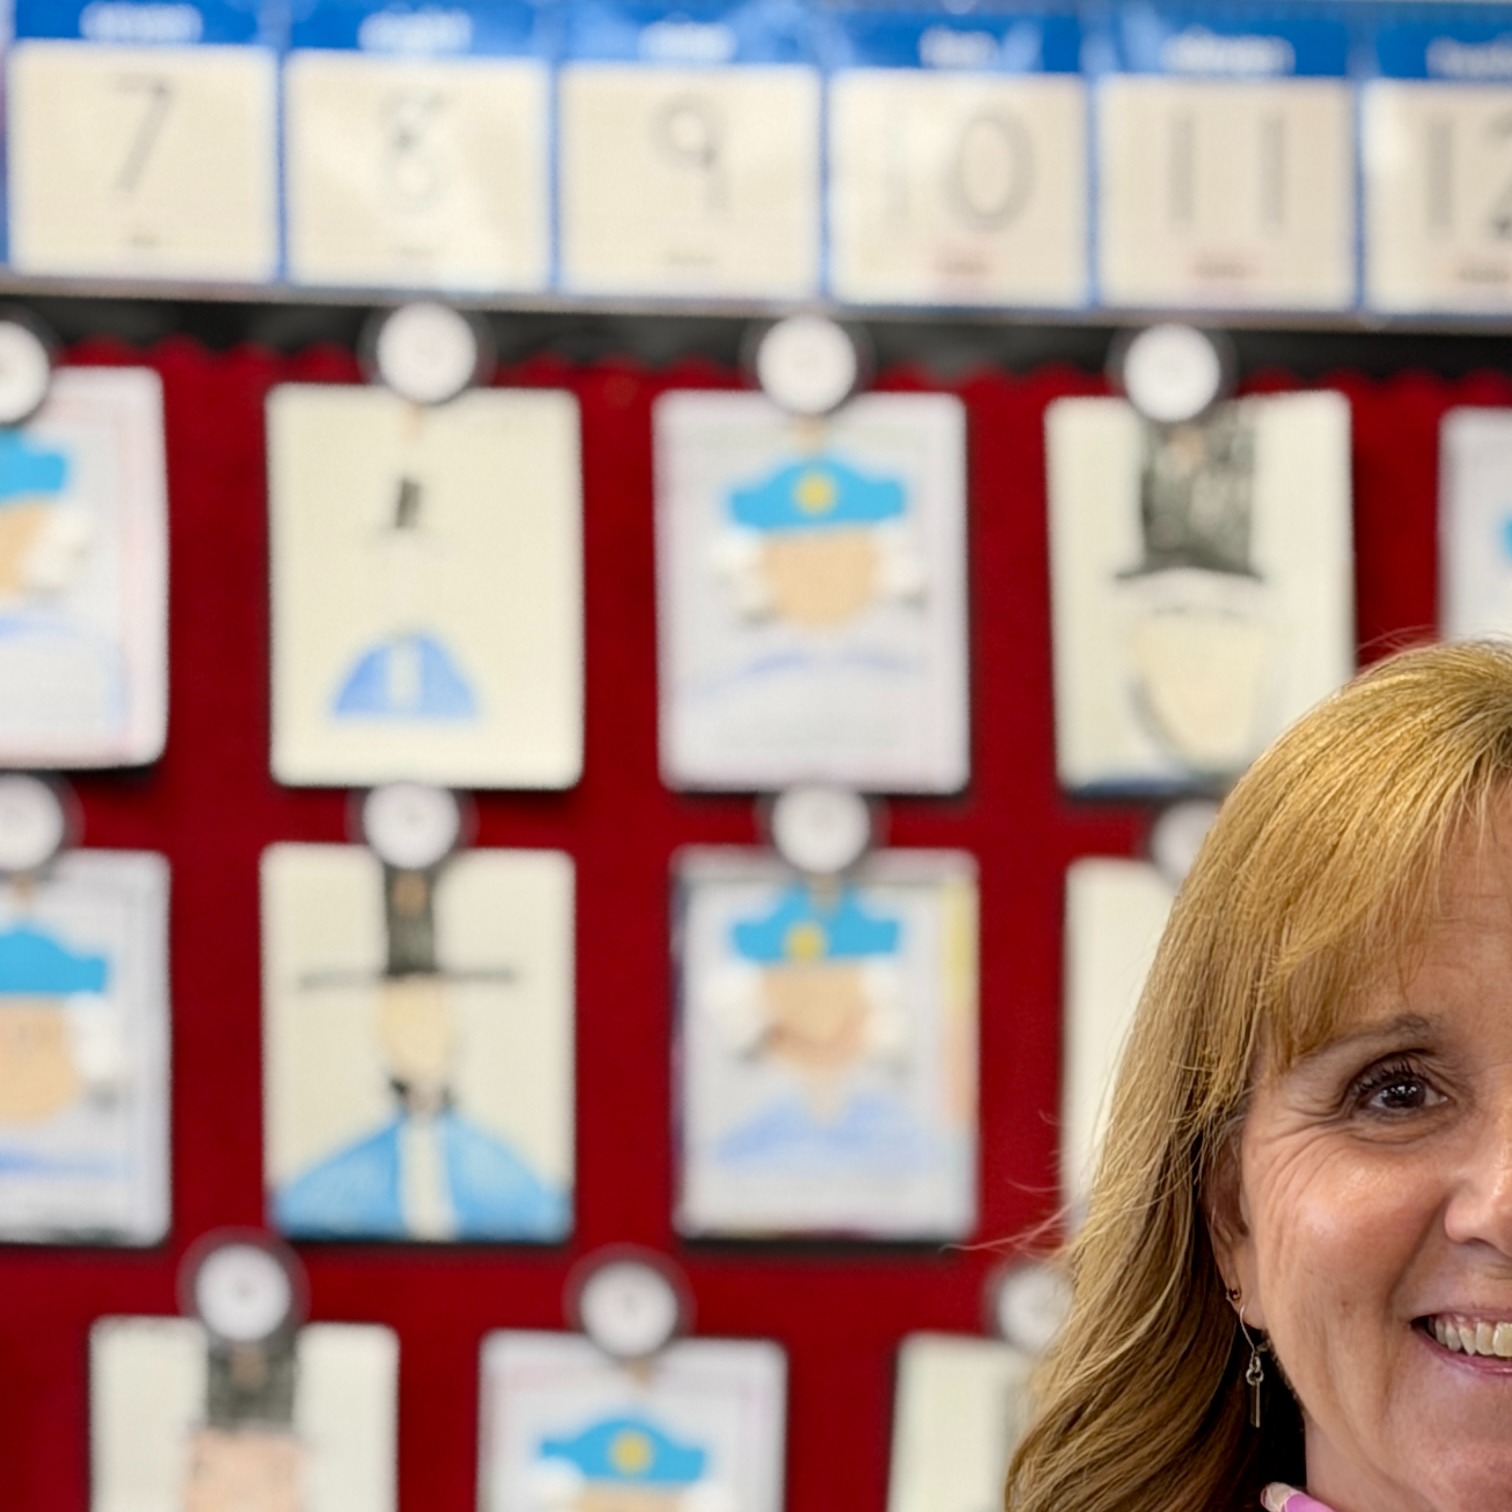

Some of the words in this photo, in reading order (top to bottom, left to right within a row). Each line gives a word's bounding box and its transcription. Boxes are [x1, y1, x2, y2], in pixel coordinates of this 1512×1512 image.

[112, 70, 172, 196] 7
[378, 88, 448, 210] 8
[648, 92, 732, 214] 9
[884, 108, 1036, 236] 10
[1164, 110, 1290, 236] 11
